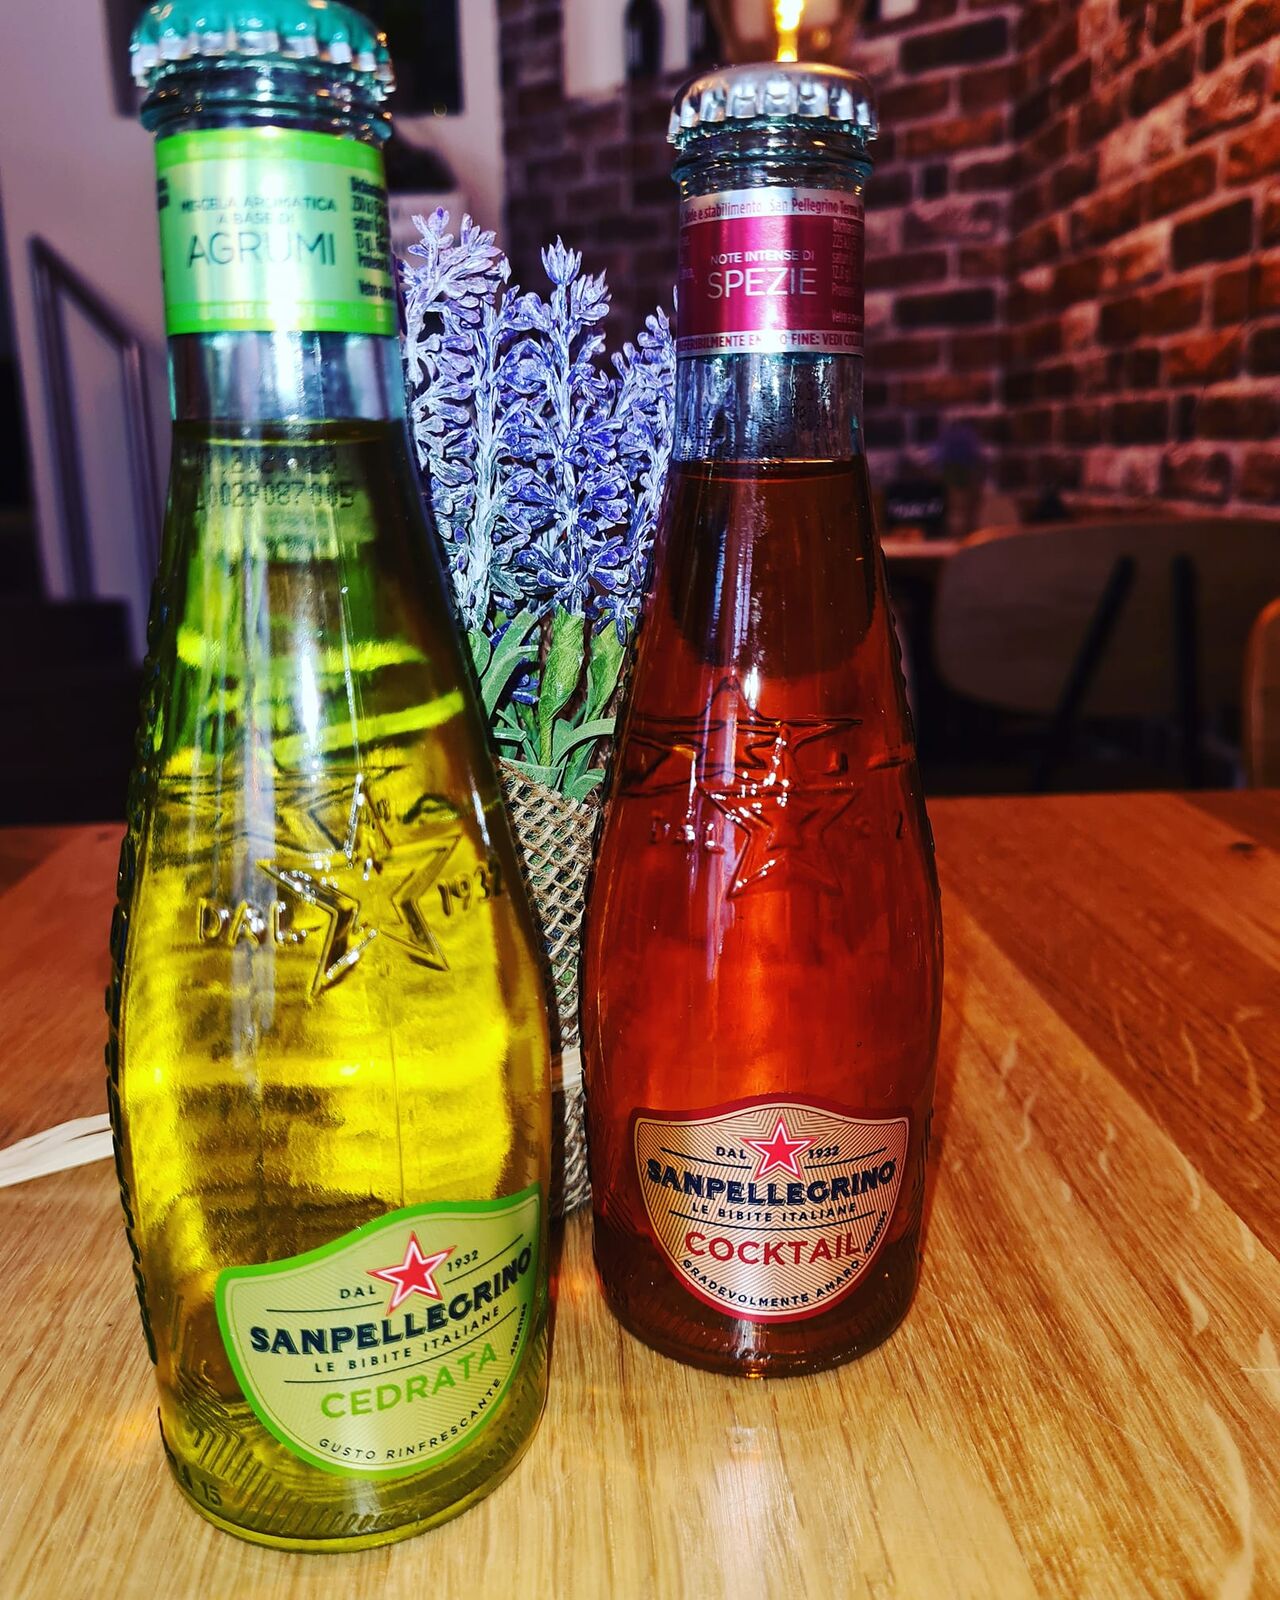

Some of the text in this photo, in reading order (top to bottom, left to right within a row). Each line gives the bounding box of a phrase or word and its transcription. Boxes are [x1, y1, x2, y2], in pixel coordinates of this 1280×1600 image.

[792, 198, 838, 214] Pellegrino
[187, 231, 336, 269] AGRUMI
[711, 250, 814, 265] NOTE INTENSE DI
[707, 267, 818, 299] SPEZIE
[791, 333, 819, 345] FINE:
[823, 333, 843, 345] VEDI
[198, 899, 308, 945] DAL
[716, 1145, 840, 1160] DAL 1932
[647, 1158, 896, 1207] SANPELLEGRINO
[692, 1202, 857, 1222] LE BIBITE ITALIANE
[684, 1231, 862, 1266] COCKTAIL
[340, 1249, 480, 1299] DAL 1932
[683, 1260, 860, 1307] GRADEVOLMENTE AMARO
[251, 1243, 533, 1355] SANPELLEGRINO
[315, 1362, 336, 1373] LE
[349, 1347, 413, 1370] BIBITE
[423, 1305, 501, 1352] ITALIANE
[320, 1342, 498, 1419] CEDRATA
[319, 1378, 501, 1460] GUSTO RINFRESCANTE
